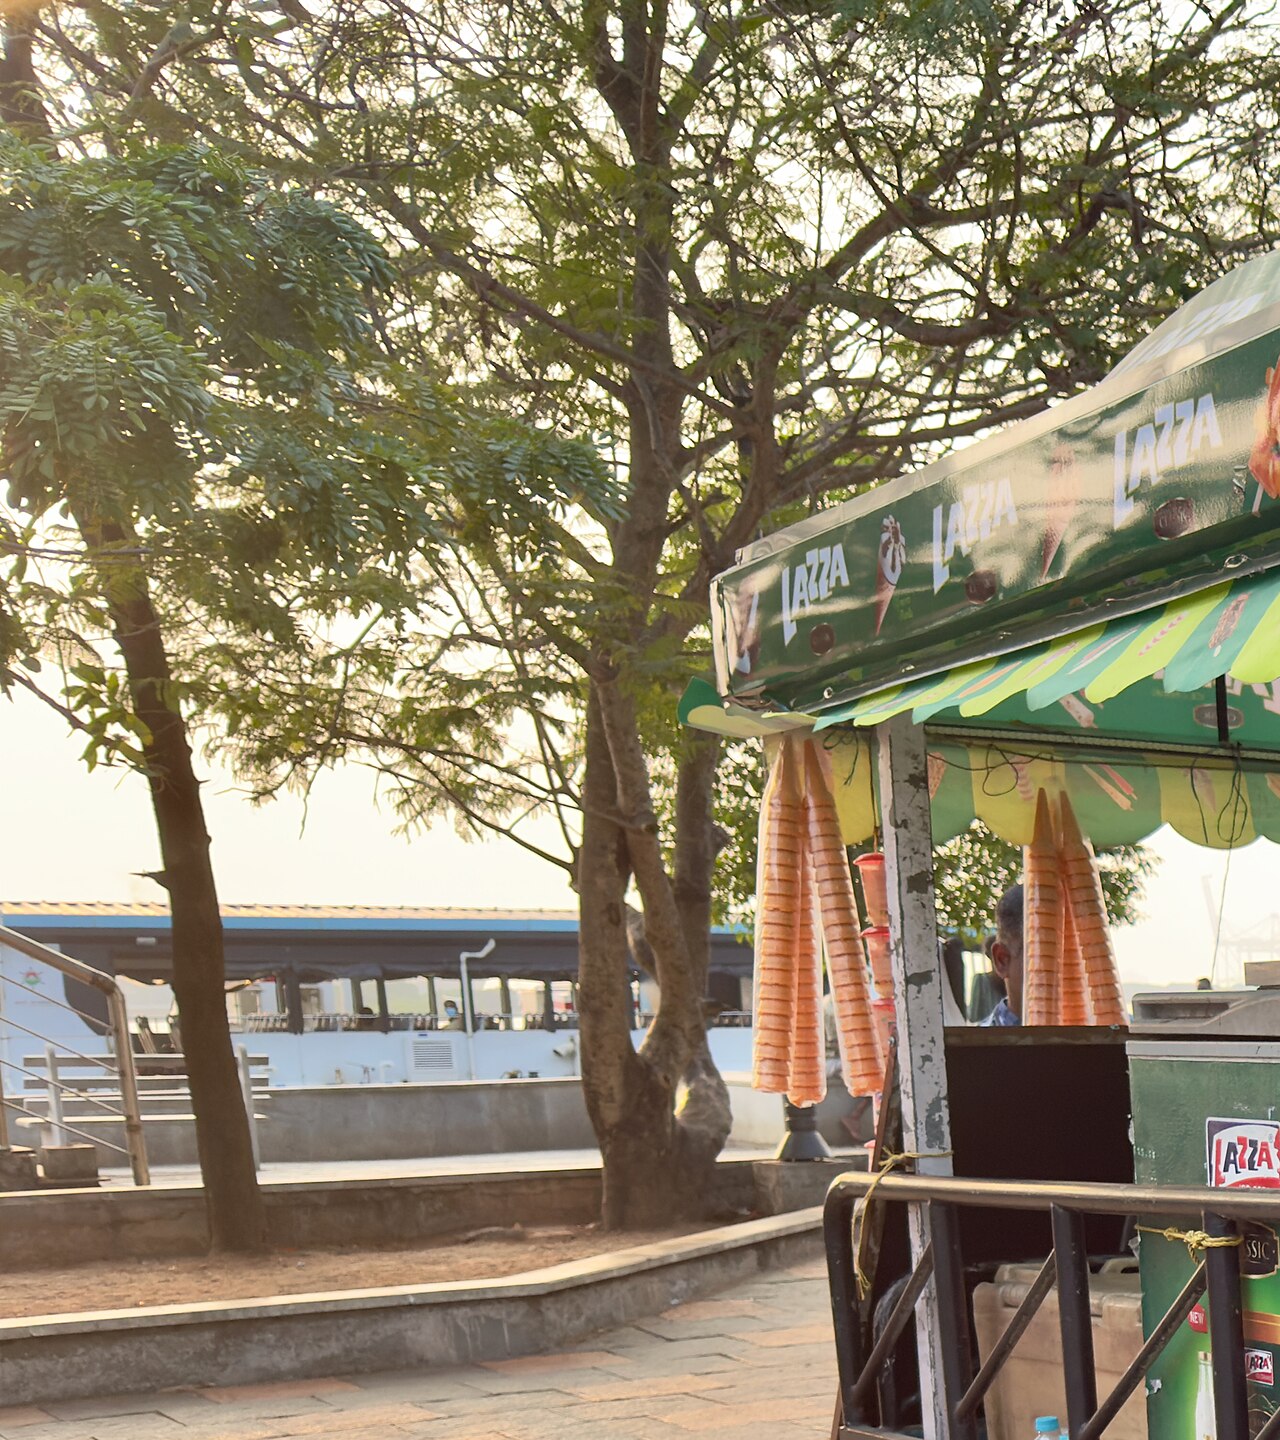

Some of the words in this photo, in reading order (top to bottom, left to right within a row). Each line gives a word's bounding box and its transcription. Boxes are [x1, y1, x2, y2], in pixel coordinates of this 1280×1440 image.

[1113, 392, 1224, 530] LAZZA
[782, 542, 850, 647] LAZZA
[933, 478, 1018, 595] LAZZA
